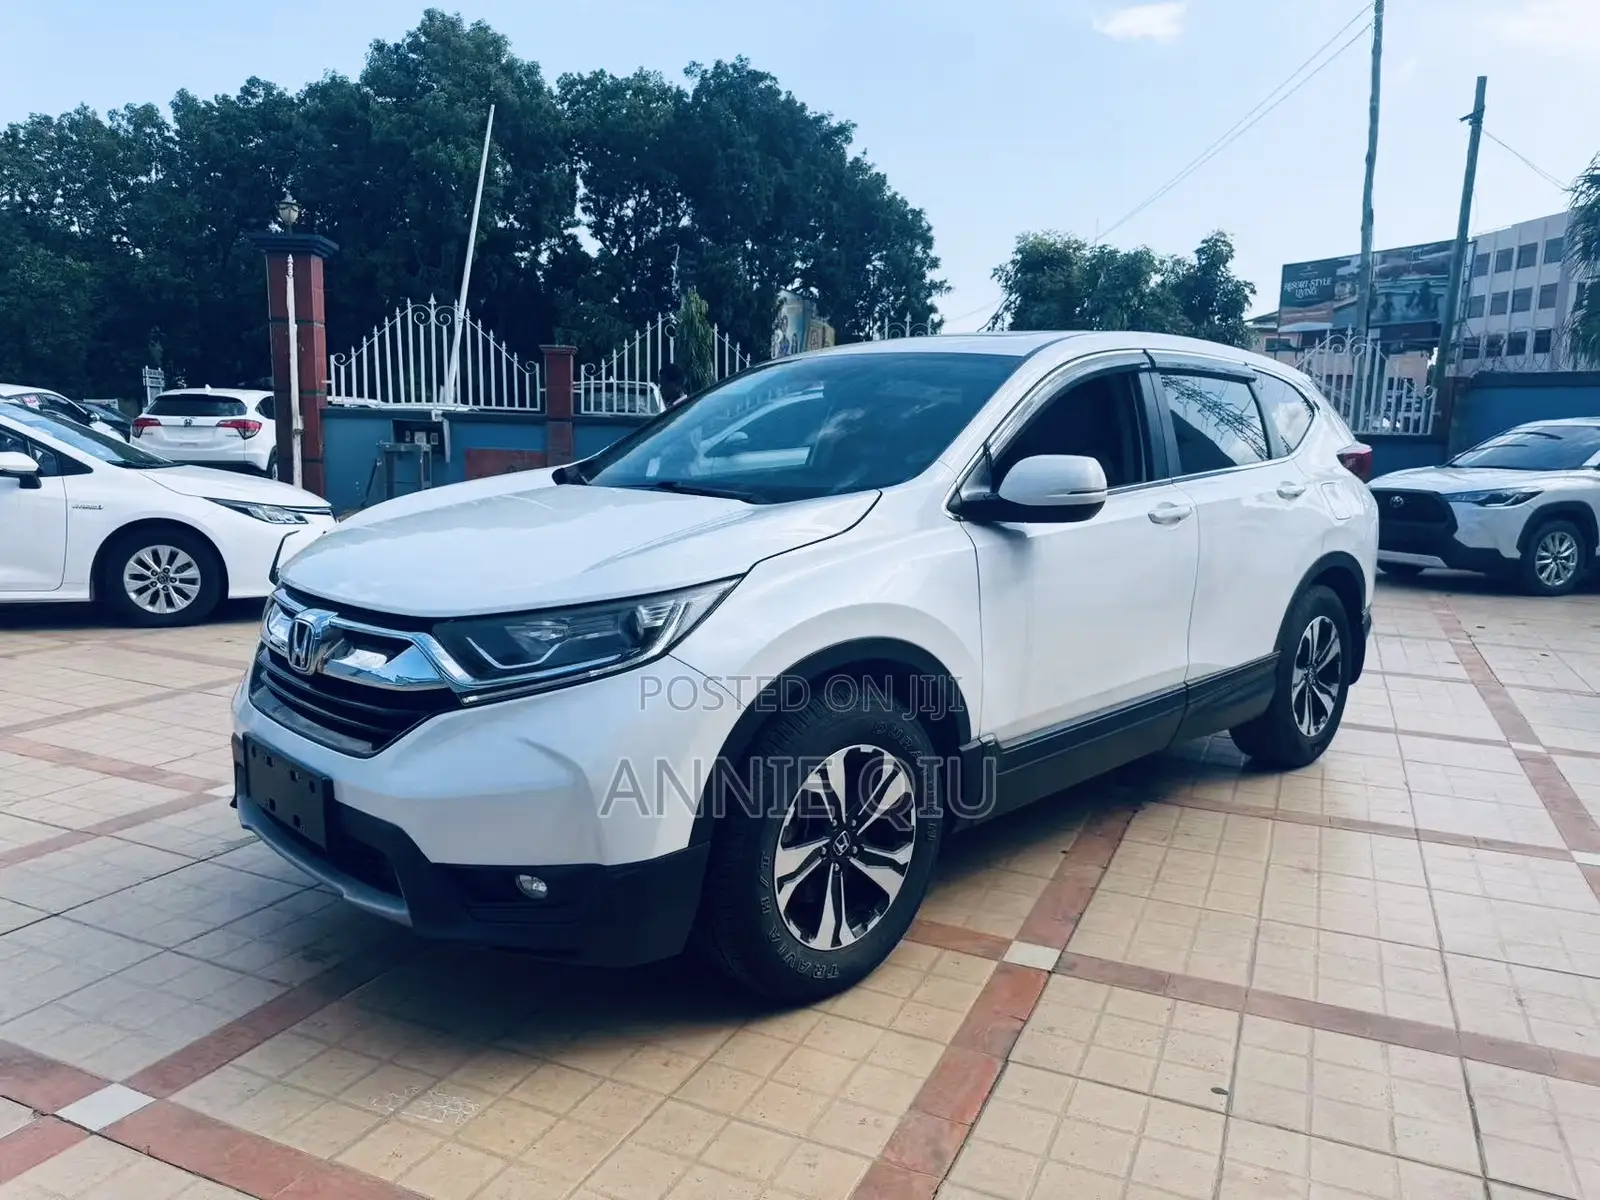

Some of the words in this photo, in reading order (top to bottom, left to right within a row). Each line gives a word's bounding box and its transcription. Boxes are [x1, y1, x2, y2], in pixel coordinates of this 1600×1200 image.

[1310, 277, 1332, 288] STYLE
[1295, 286, 1317, 299] LIVING
[768, 925, 840, 979] TRAVIA
